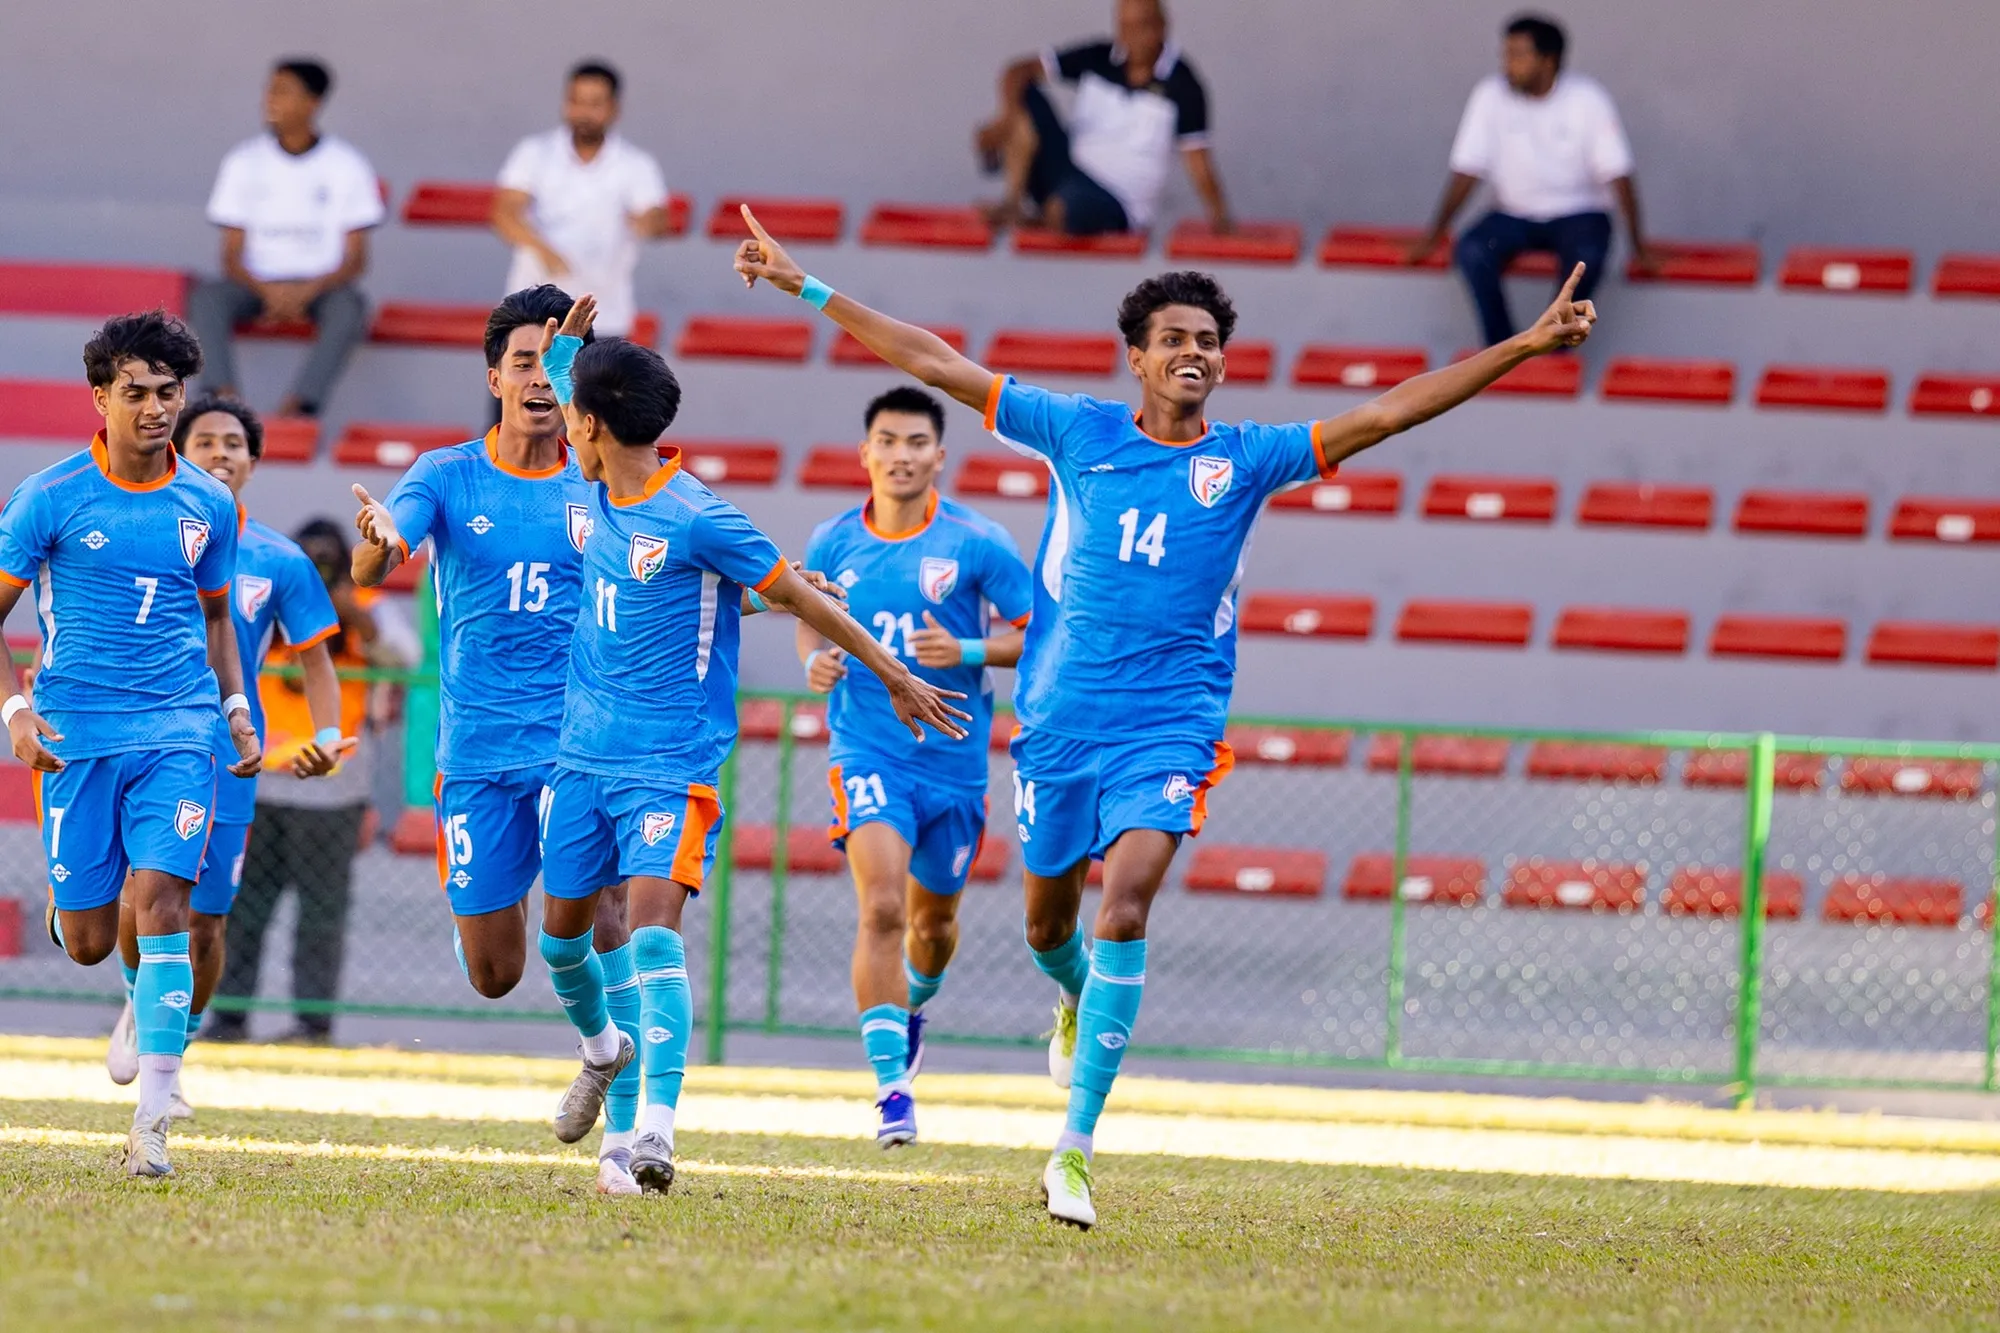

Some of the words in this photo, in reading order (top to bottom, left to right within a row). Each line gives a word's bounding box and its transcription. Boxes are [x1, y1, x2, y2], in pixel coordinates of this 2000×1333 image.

[636, 540, 654, 549] INDIA
[1118, 508, 1168, 567] 14
[135, 577, 158, 624] 7
[507, 562, 551, 612] 15
[596, 577, 618, 632] 11
[873, 611, 917, 657] 21
[845, 773, 888, 808] 21
[49, 807, 65, 858] 7
[444, 813, 473, 865] 15
